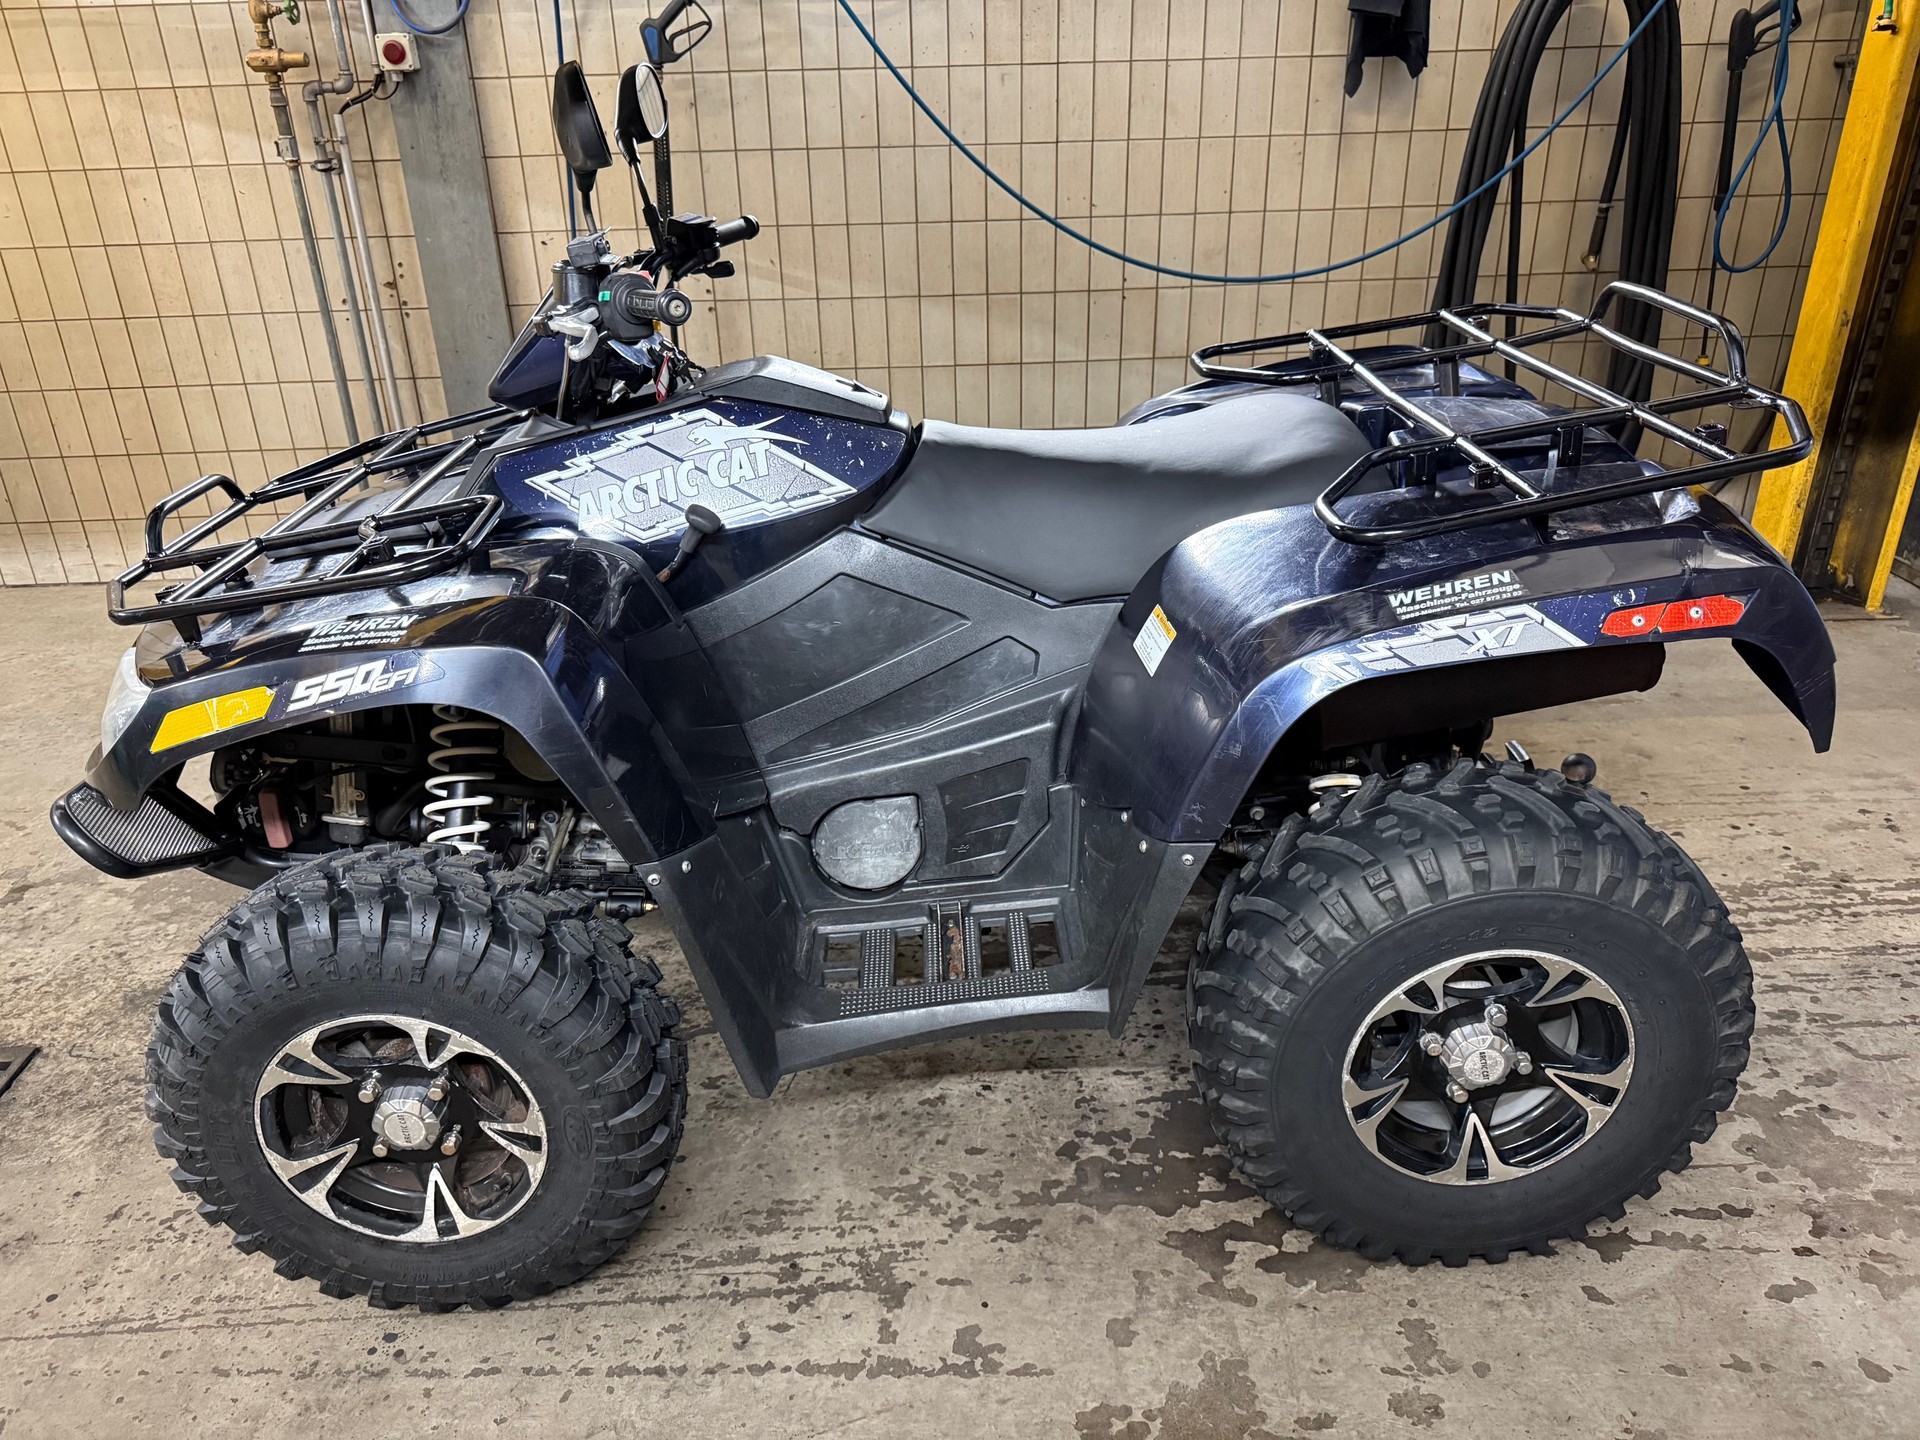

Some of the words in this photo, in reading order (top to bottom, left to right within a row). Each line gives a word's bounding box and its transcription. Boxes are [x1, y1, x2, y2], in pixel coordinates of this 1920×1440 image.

[578, 459, 700, 531] ARCTIC
[707, 440, 770, 488] CAT
[1388, 570, 1511, 608] WEHREN
[1396, 583, 1520, 615] Maschinen-Fahrzeuge
[308, 614, 419, 637] WEHREN
[303, 630, 407, 646] Maschinen-Fahrzeuge
[1462, 620, 1536, 655] XT
[1479, 1052, 1488, 1070] ARCTIC
[1482, 1070, 1490, 1080] CAT
[397, 1114, 406, 1124] CAT
[401, 1125, 412, 1144] ARCTIC
